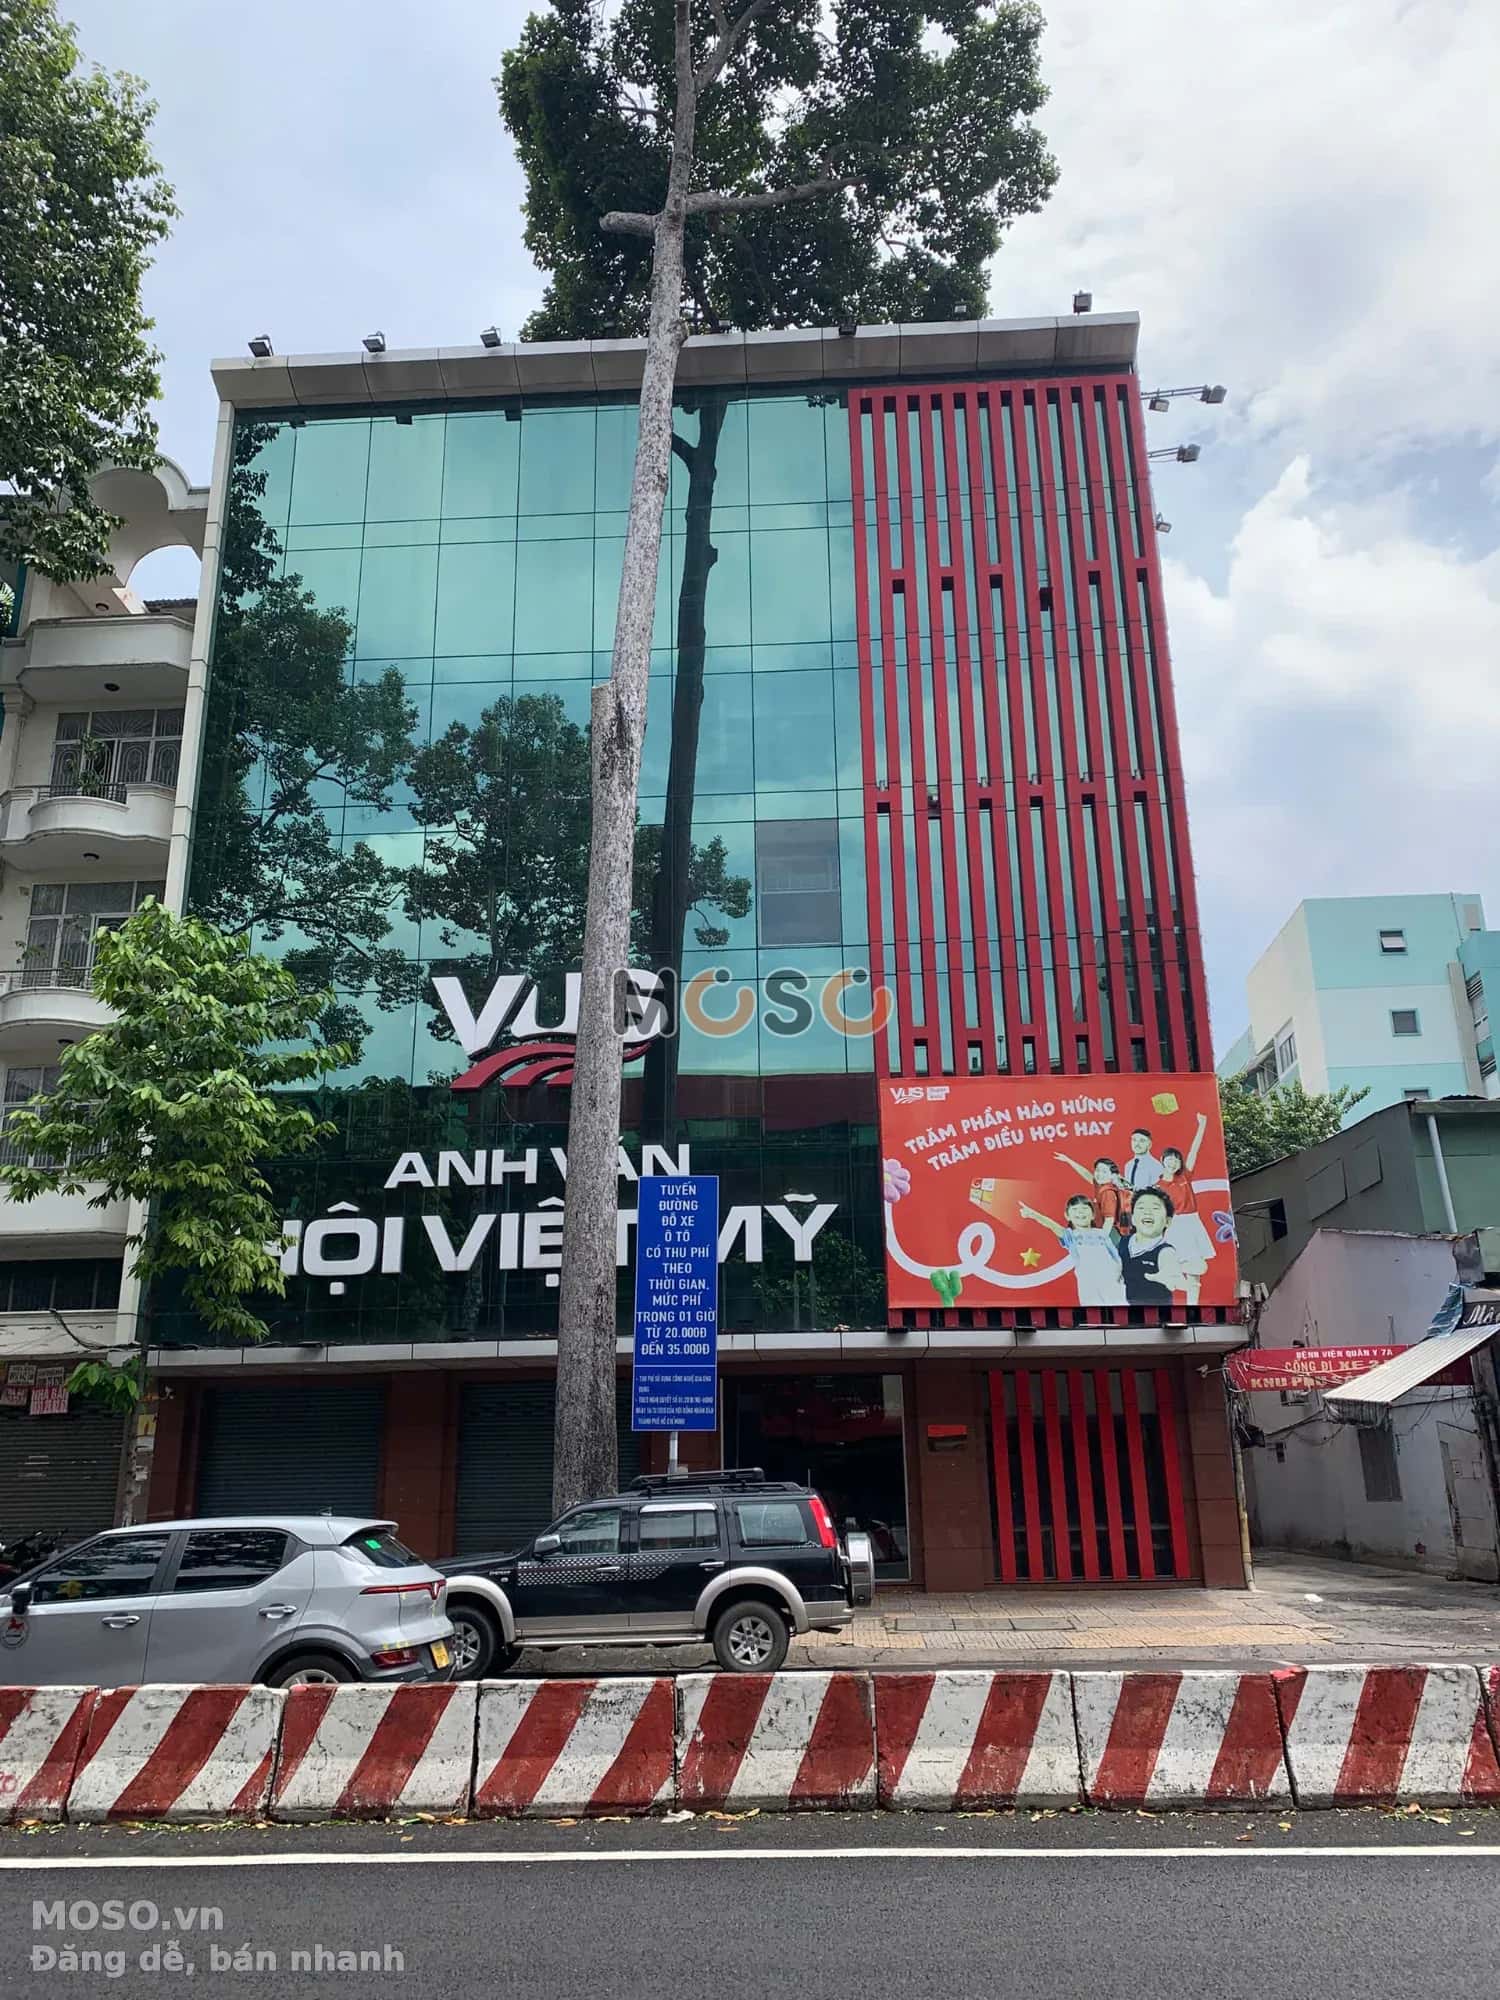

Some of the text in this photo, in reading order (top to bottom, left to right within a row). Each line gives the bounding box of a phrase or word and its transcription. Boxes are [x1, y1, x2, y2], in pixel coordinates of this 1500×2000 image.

[890, 1087, 924, 1100] VUS
[904, 1094, 1116, 1154] TRĂM PHẦN HÀO HỨNG
[927, 1121, 1114, 1171] TRĂM ĐIỀU HỌC HAY
[384, 1148, 538, 1189] ANH
[660, 1181, 697, 1196] TUYẾN
[659, 1197, 699, 1211] ĐƯỜNG
[661, 1212, 695, 1227] ĐỖ XE
[664, 1229, 690, 1242] Ô TÔ
[646, 1244, 710, 1258] CÓ THU PHÍ
[662, 1262, 692, 1274] THEO
[648, 1276, 710, 1290] THỜI GIAN.
[652, 1291, 702, 1306] MỨC PHÍ
[636, 1306, 716, 1323] TRONG 01 GIỜ
[645, 1324, 707, 1339] TỪ 20.000Đ
[641, 1340, 710, 1355] ĐẾN 35.000Đ
